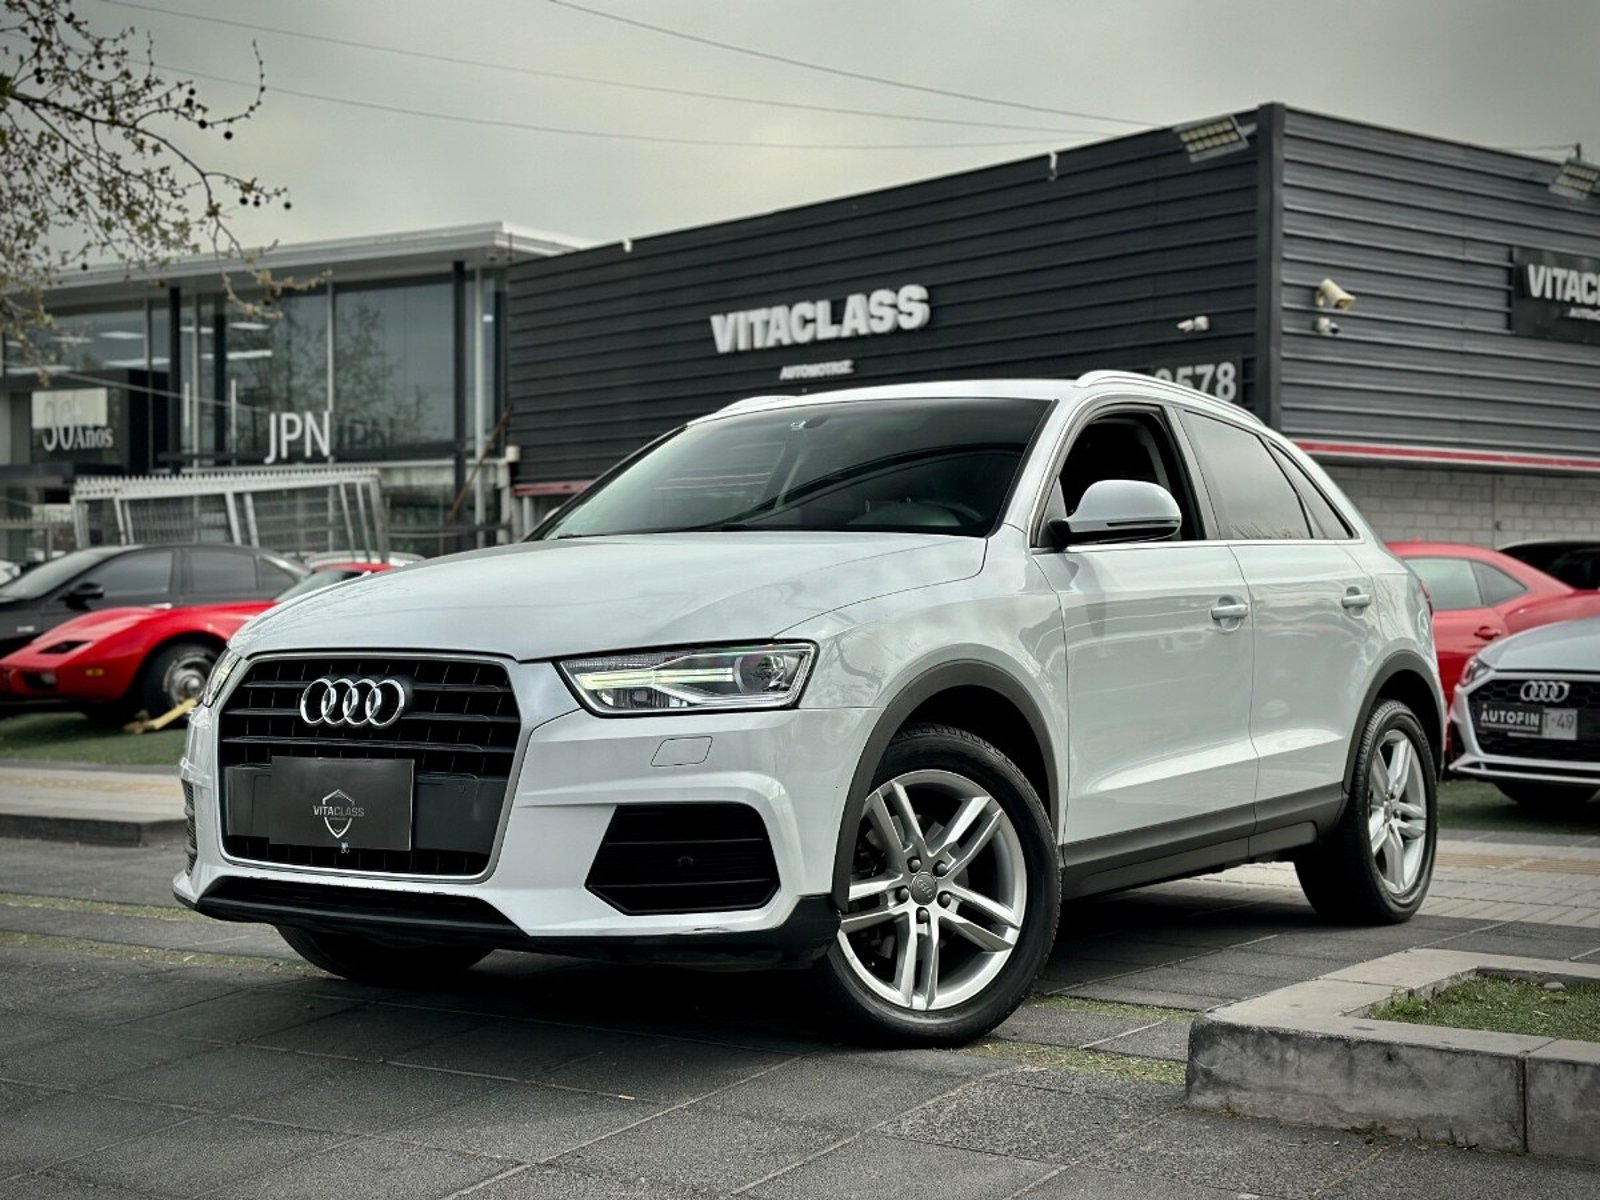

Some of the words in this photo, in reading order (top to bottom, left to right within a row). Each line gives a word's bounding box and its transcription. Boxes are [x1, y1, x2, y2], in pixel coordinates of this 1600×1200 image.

[1527, 263, 1600, 306] VITAC
[710, 284, 931, 354] VITACLASS
[264, 410, 331, 465] JPN
[1480, 709, 1540, 727] AUTOFIN
[312, 804, 365, 817] VITACLASS
